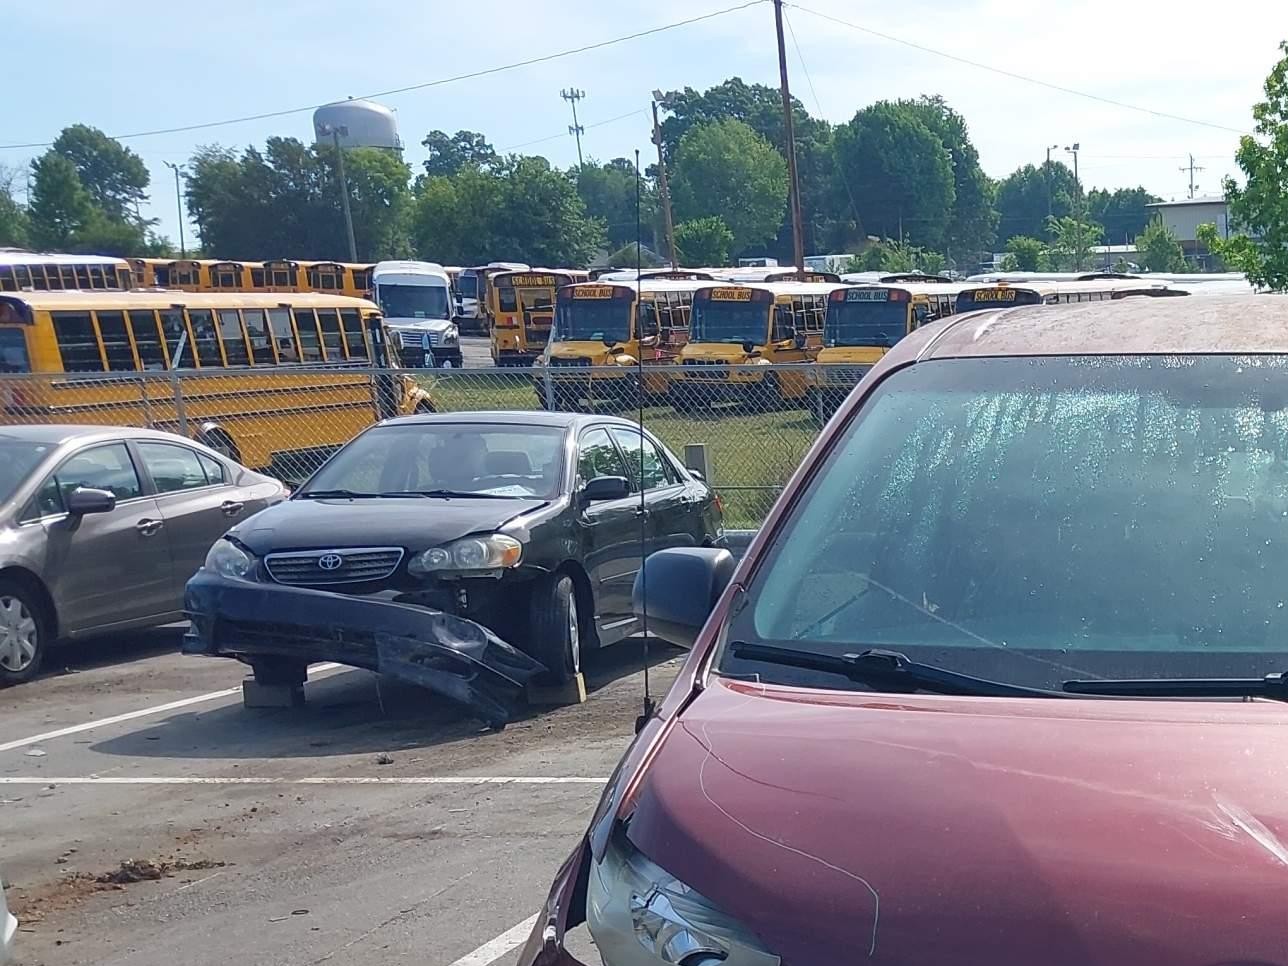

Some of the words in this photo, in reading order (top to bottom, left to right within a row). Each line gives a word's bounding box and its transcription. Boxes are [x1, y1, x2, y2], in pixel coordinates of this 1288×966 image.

[575, 288, 598, 297] SCHOOL
[599, 288, 613, 297] BUS
[712, 290, 735, 300] SCHOOL
[737, 290, 751, 300] BUS
[847, 290, 872, 300] SCHOOL
[873, 290, 888, 300] BUS
[976, 290, 998, 300] SCHOOL
[999, 290, 1015, 300] BUS
